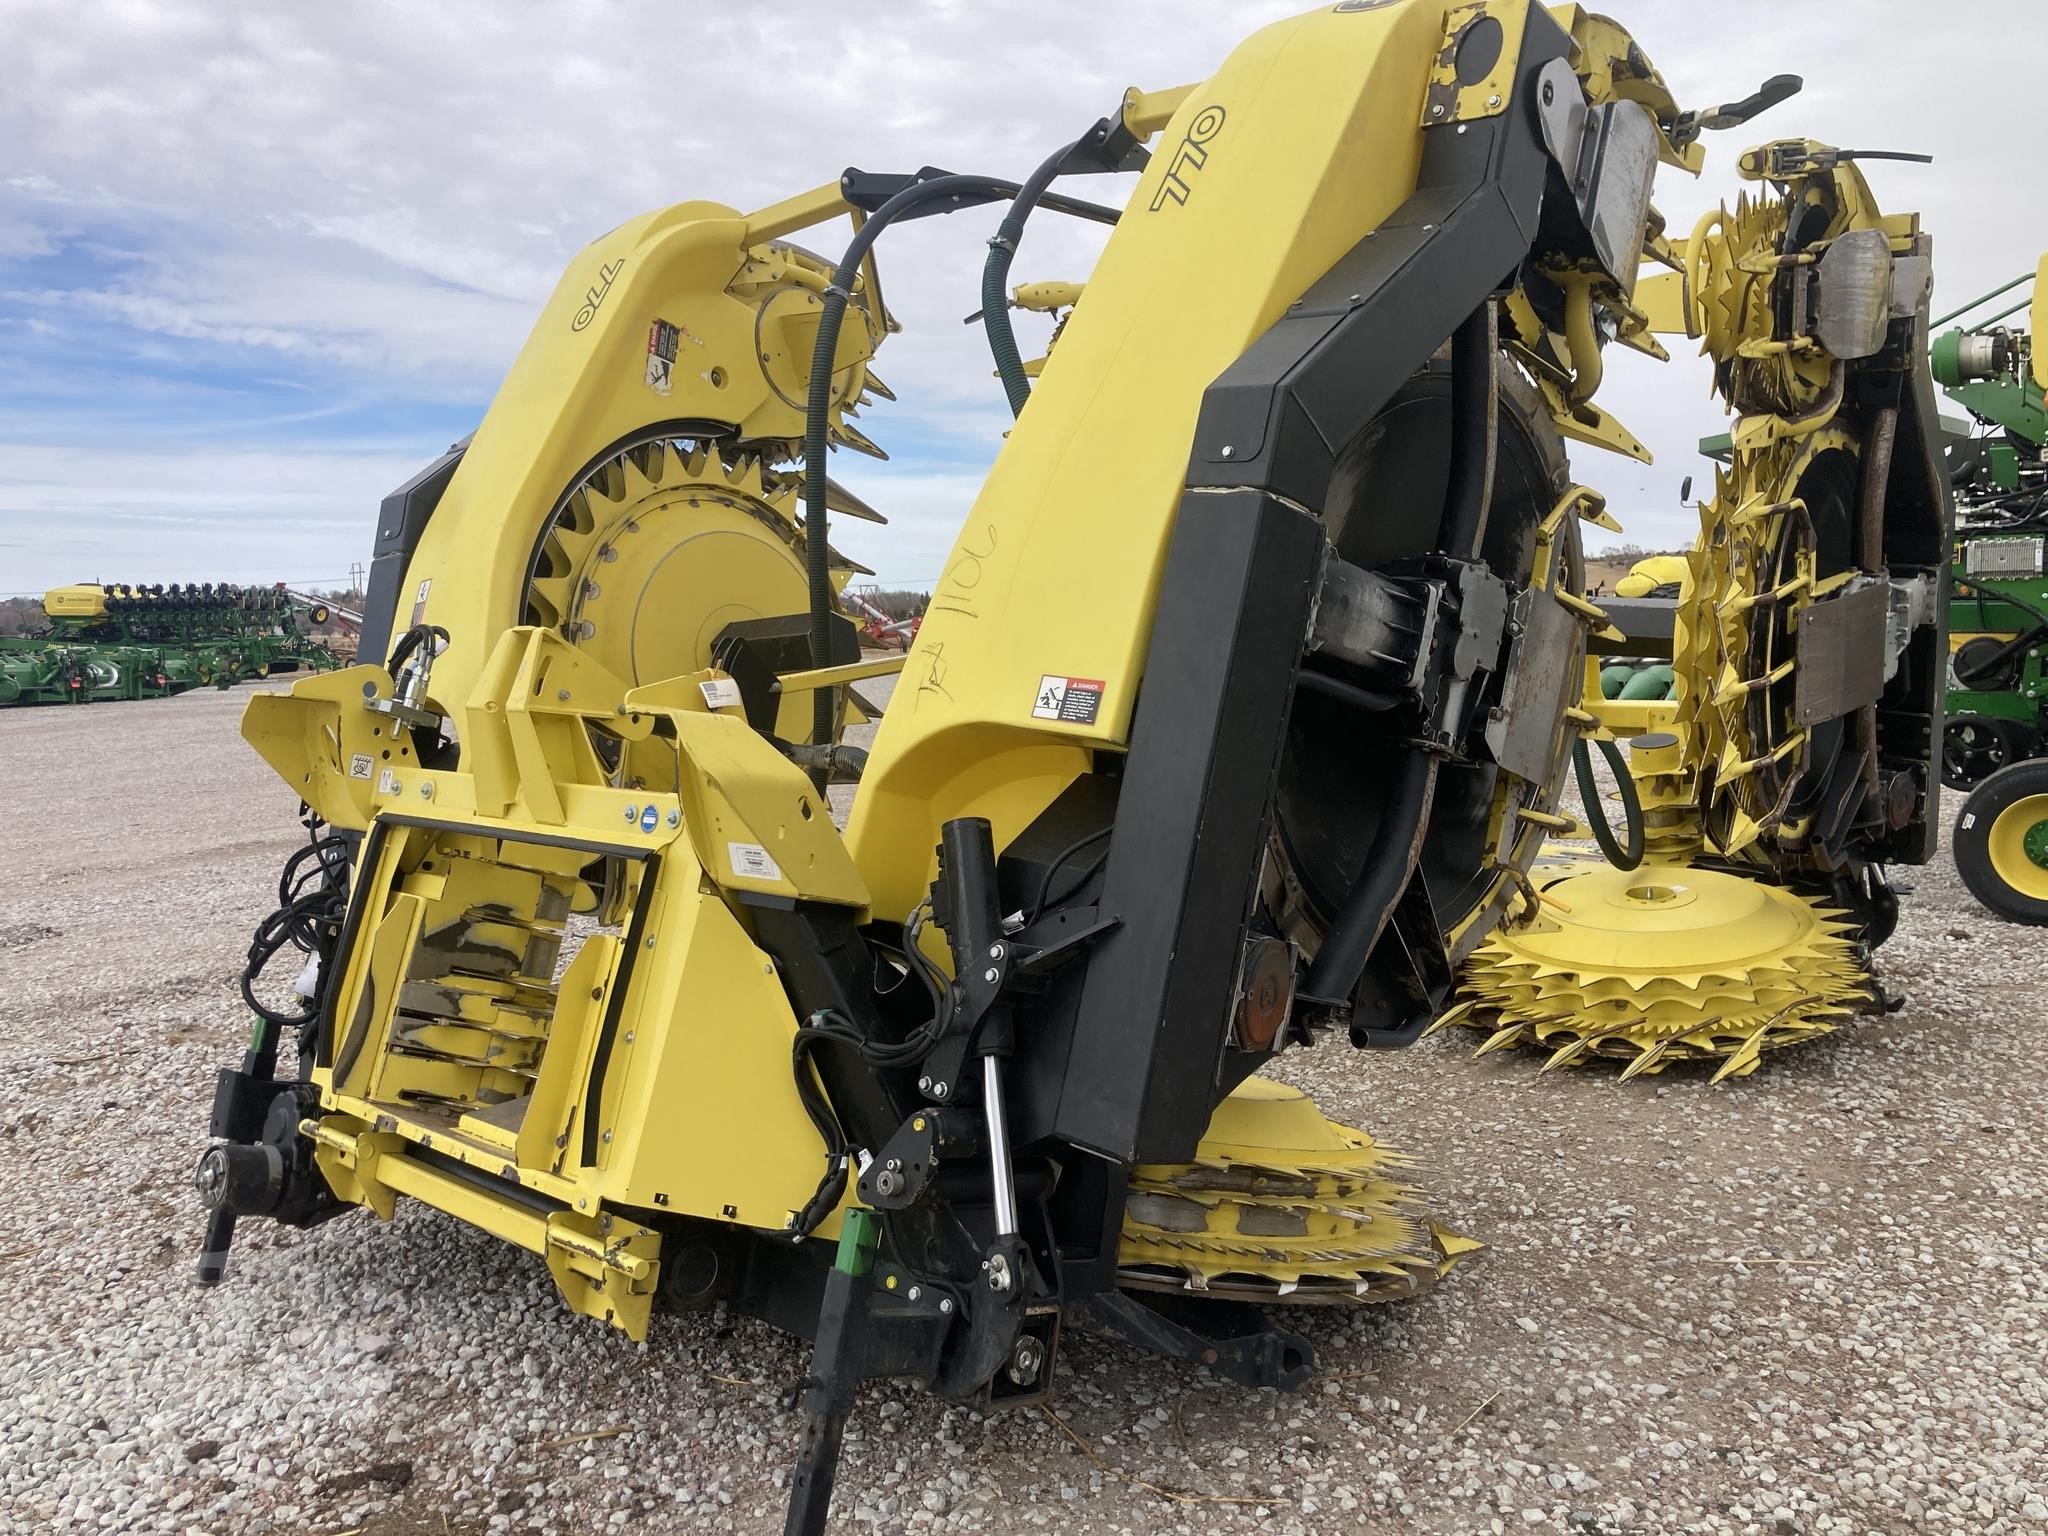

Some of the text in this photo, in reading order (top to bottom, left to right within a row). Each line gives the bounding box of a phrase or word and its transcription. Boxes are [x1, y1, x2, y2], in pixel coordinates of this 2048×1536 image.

[1148, 105, 1226, 212] 770
[571, 258, 626, 332] 770
[1077, 682, 1099, 690] DANGER
